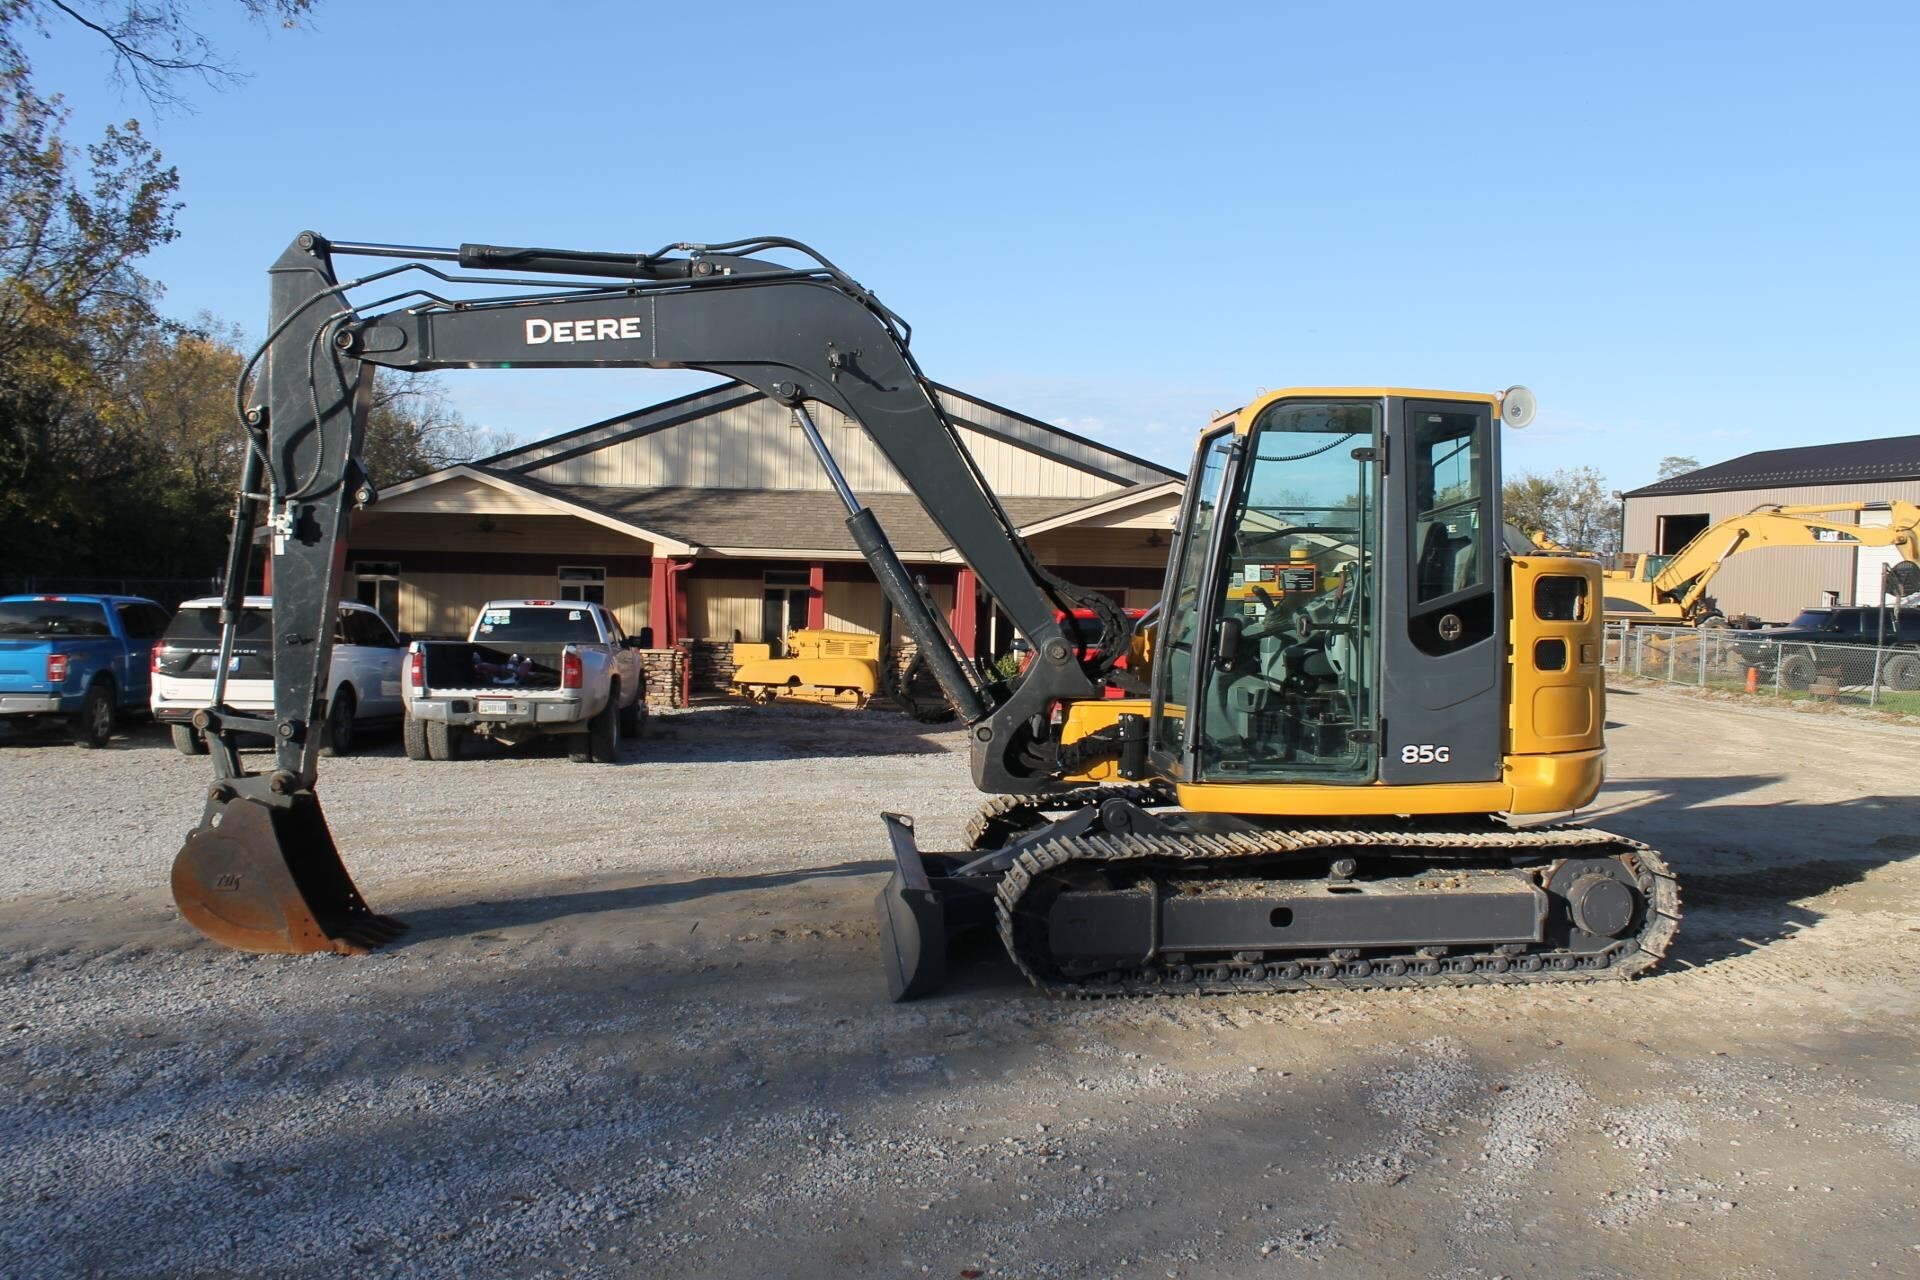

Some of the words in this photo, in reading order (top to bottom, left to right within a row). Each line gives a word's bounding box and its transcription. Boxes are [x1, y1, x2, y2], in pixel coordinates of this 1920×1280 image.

[525, 317, 641, 345] DEERE
[1820, 530, 1840, 541] CAT
[1401, 744, 1450, 764] 85G
